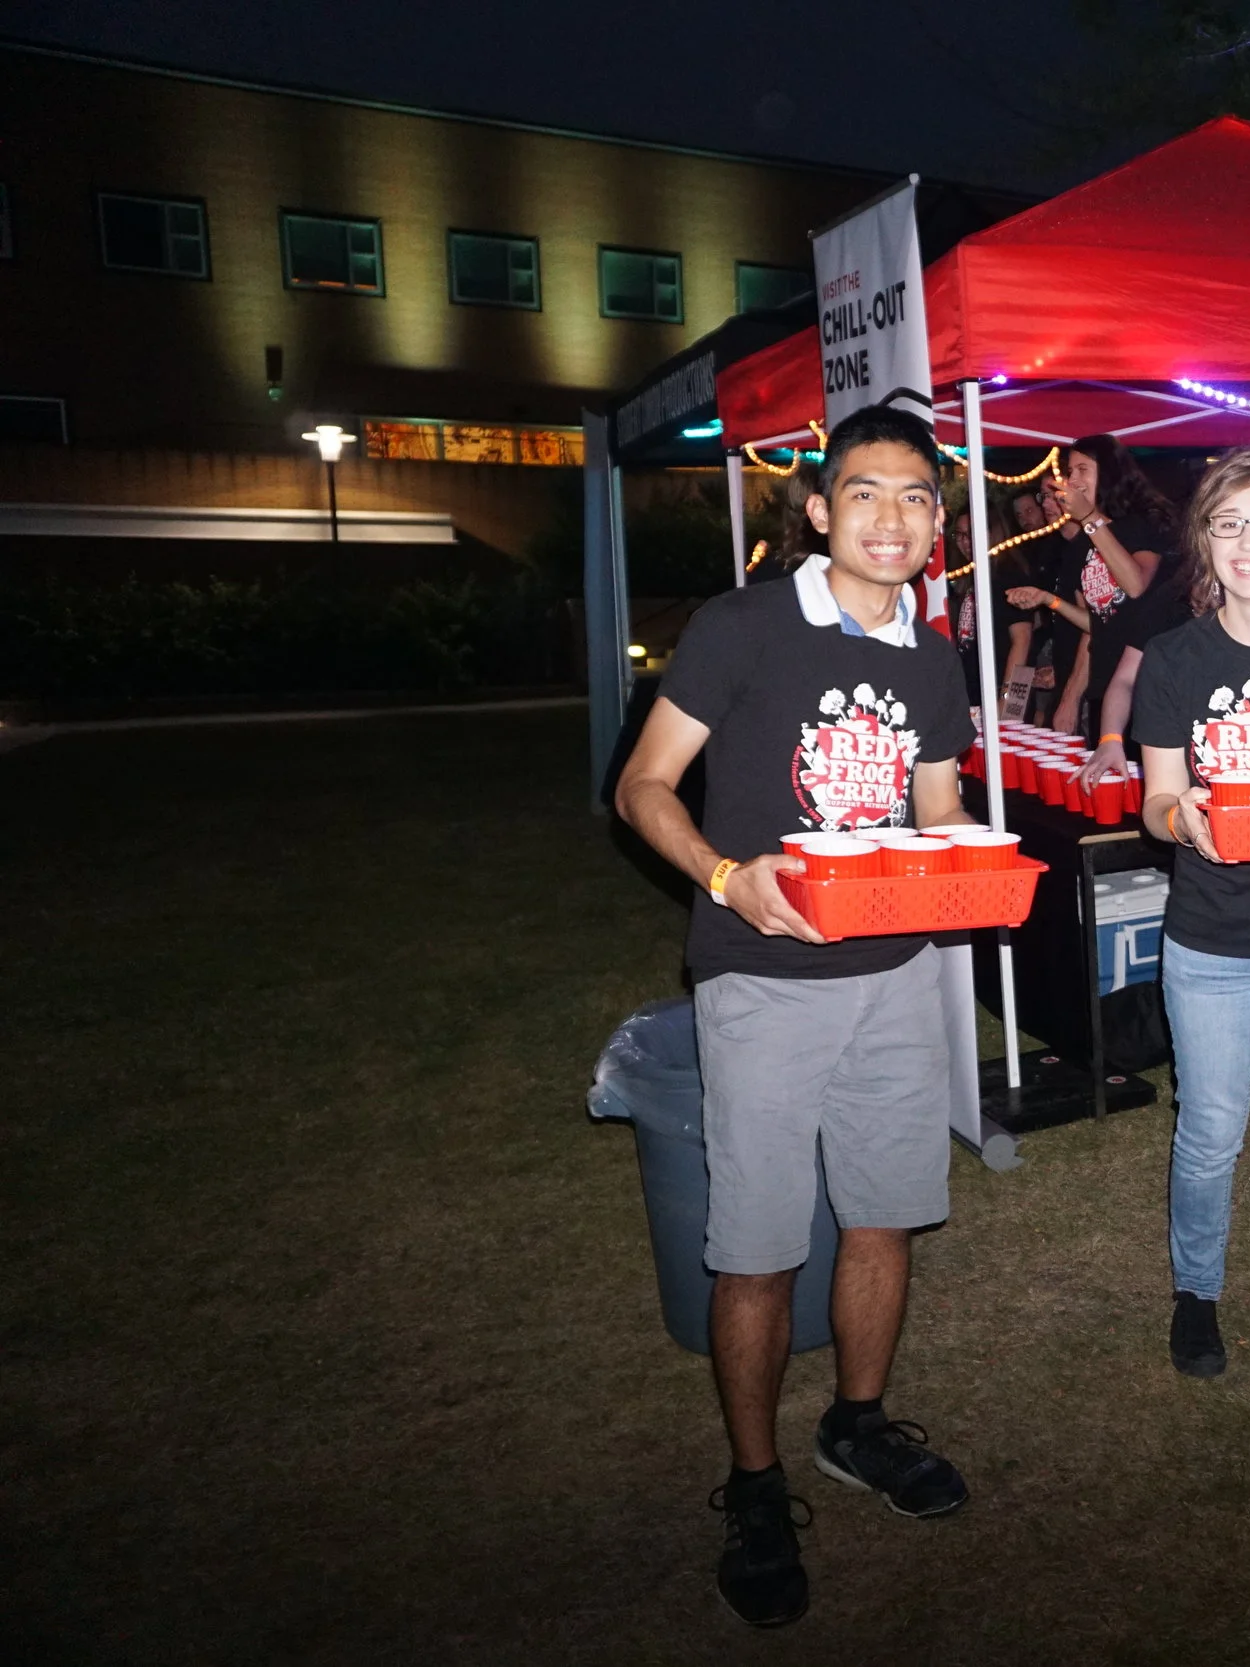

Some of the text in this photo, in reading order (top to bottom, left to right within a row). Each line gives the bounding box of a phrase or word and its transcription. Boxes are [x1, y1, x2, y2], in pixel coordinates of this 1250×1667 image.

[822, 270, 861, 301] VISIT THE
[823, 280, 906, 346] CHILL-OUT
[824, 349, 870, 394] ZONE
[1088, 584, 1113, 600] CREW
[829, 730, 898, 763] RED
[828, 760, 896, 785] FROG
[825, 781, 892, 803] CREW
